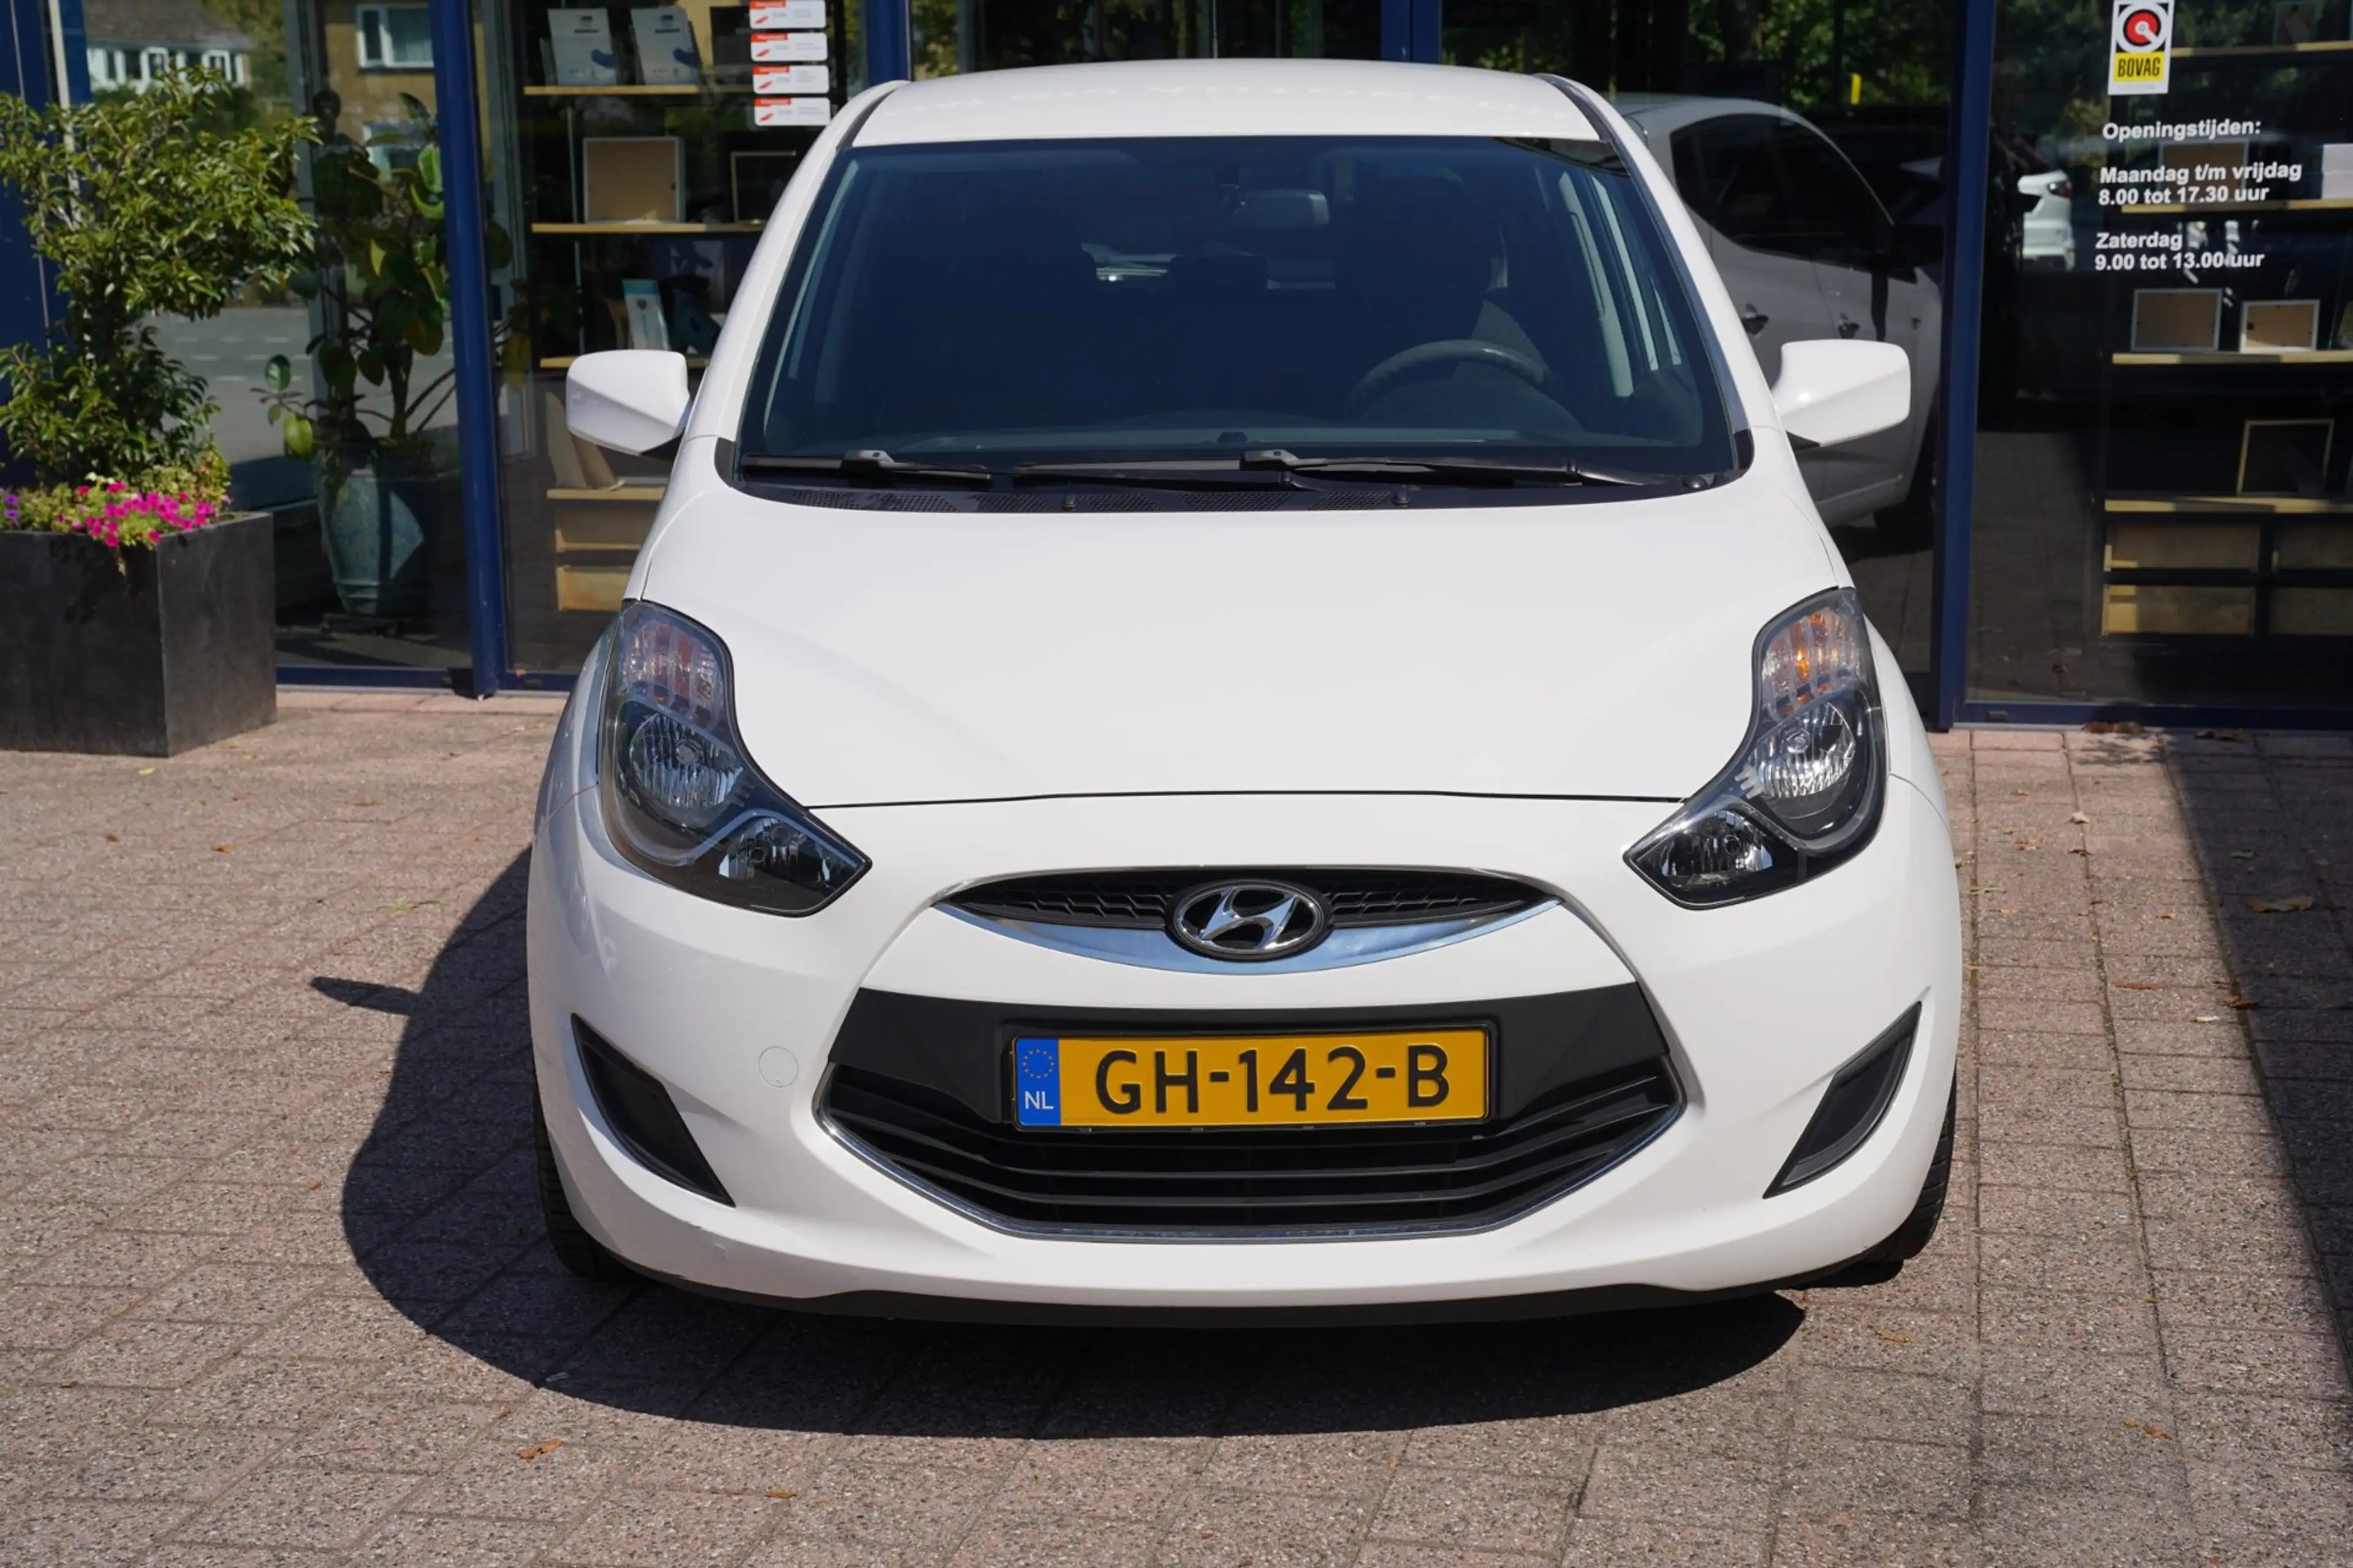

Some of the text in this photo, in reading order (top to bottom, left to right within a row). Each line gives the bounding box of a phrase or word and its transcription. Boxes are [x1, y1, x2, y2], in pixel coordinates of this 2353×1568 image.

[2118, 56, 2161, 78] BOVAG
[2102, 119, 2261, 141] Openingstijden:
[2100, 162, 2302, 184] Maandag t/m vrijdag
[2099, 186, 2270, 205] 8.00 tot 17.30 uur
[2096, 232, 2183, 251] Zaterdag
[2095, 252, 2265, 271] 9.00 tot 13.00 uur
[1095, 1043, 1450, 1115] GH-142-B
[1025, 1091, 1053, 1110] NL
